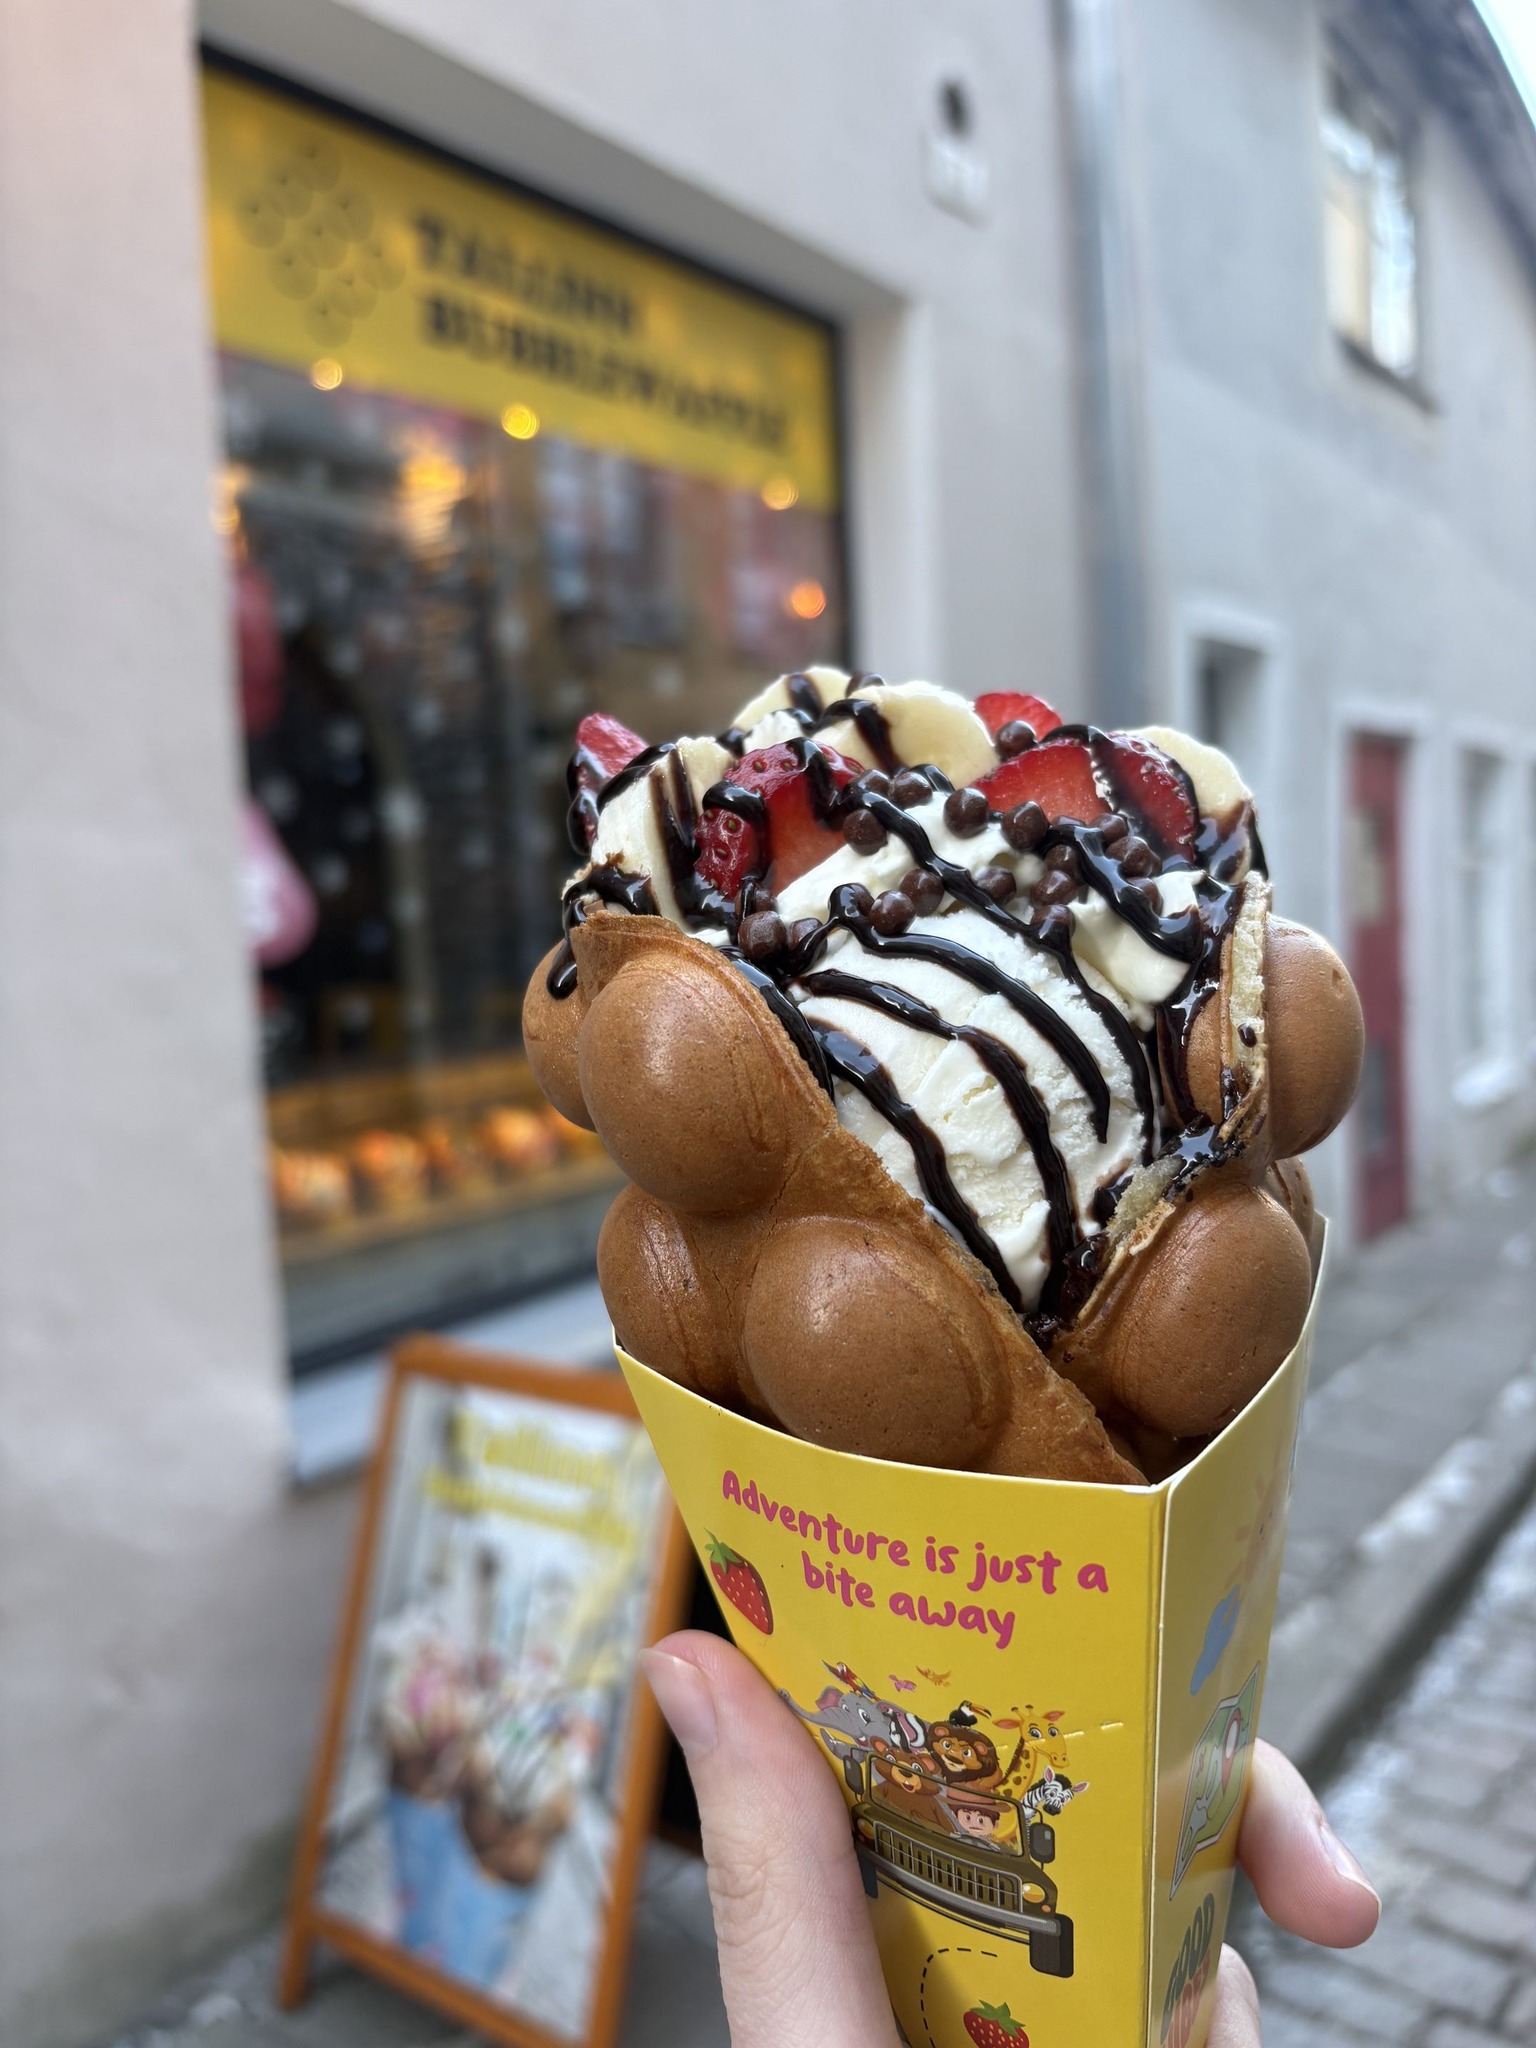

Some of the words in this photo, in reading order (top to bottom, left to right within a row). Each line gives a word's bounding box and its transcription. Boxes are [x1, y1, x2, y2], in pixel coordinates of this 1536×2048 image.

[722, 1471, 910, 1567] Adventure
[925, 1536, 960, 1574] is
[966, 1542, 1062, 1595] just
[1077, 1563, 1109, 1593] a
[801, 1550, 876, 1608] bite
[888, 1591, 1016, 1650] away
[1160, 1893, 1215, 2046] GOOD
